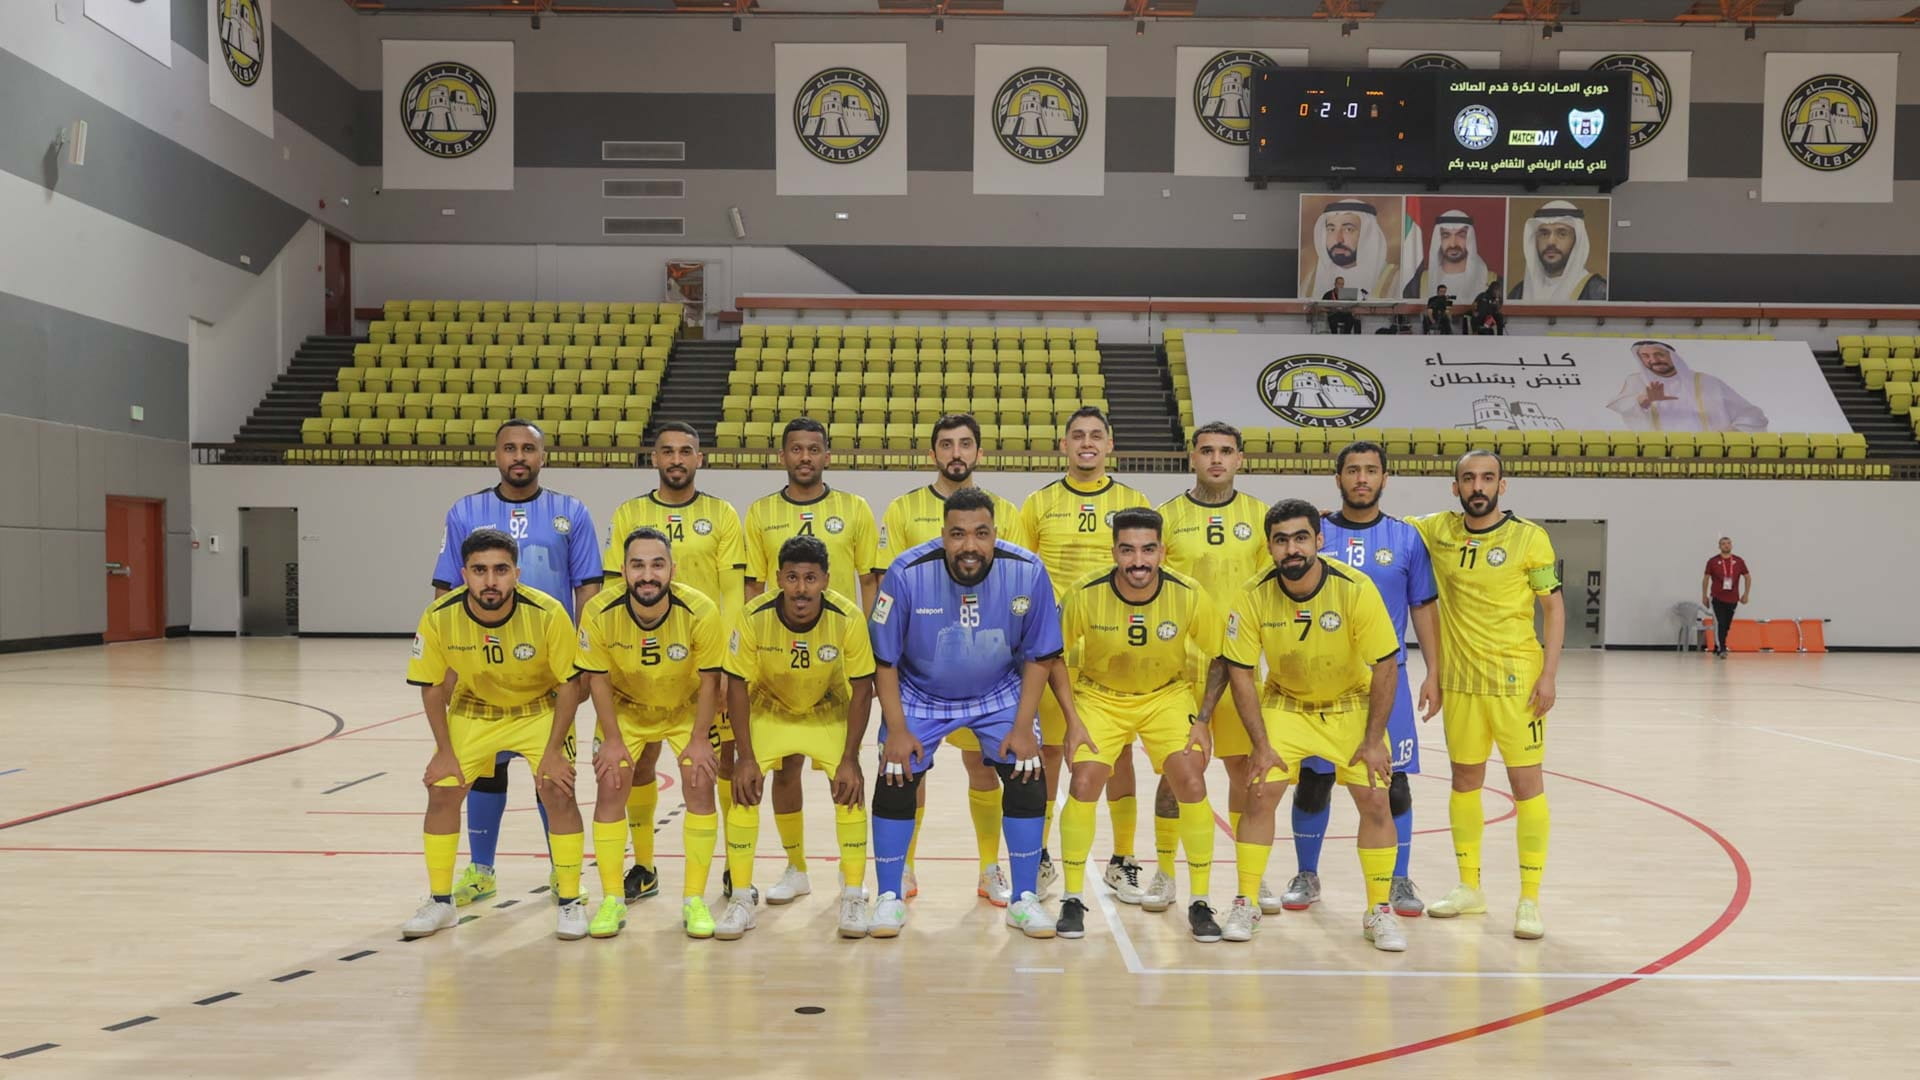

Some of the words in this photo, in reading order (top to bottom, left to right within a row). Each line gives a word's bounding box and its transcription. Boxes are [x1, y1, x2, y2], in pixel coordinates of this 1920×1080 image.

[1450, 82, 1486, 92] الصالات
[1488, 83, 1509, 94] قدم
[1512, 82, 1535, 95] لكرة
[1583, 85, 1609, 97] دوري
[1320, 103, 1331, 118] 2
[424, 139, 473, 154] KALBA
[817, 144, 866, 159] KALBA
[1015, 144, 1064, 159] KALBA
[1448, 158, 1464, 171] بكم
[1466, 160, 1488, 171] يرحب
[1490, 158, 1525, 173] الثقافي
[1527, 159, 1562, 173] الرياضي
[1563, 159, 1585, 170] كلباء
[1586, 160, 1607, 174] نادي
[1804, 151, 1852, 167] KALBA
[1425, 352, 1576, 371] كلباء
[1526, 373, 1581, 389] تنبض
[1294, 413, 1360, 427] KALBA
[509, 517, 529, 539] 92
[796, 521, 815, 537] 4
[1078, 512, 1097, 532] 20
[666, 523, 684, 542] 14
[1206, 525, 1225, 546] 6
[1346, 546, 1365, 567] 13
[1460, 546, 1477, 569] 11
[1586, 570, 1601, 634] EXIT
[915, 607, 944, 616] uhlsport
[959, 604, 981, 628] 85
[1128, 625, 1147, 647] 9
[1294, 619, 1313, 641] 7
[482, 644, 504, 664] 10
[641, 645, 661, 666] 5
[790, 648, 810, 669] 28
[1528, 719, 1543, 743] 11
[1398, 738, 1414, 761] 13
